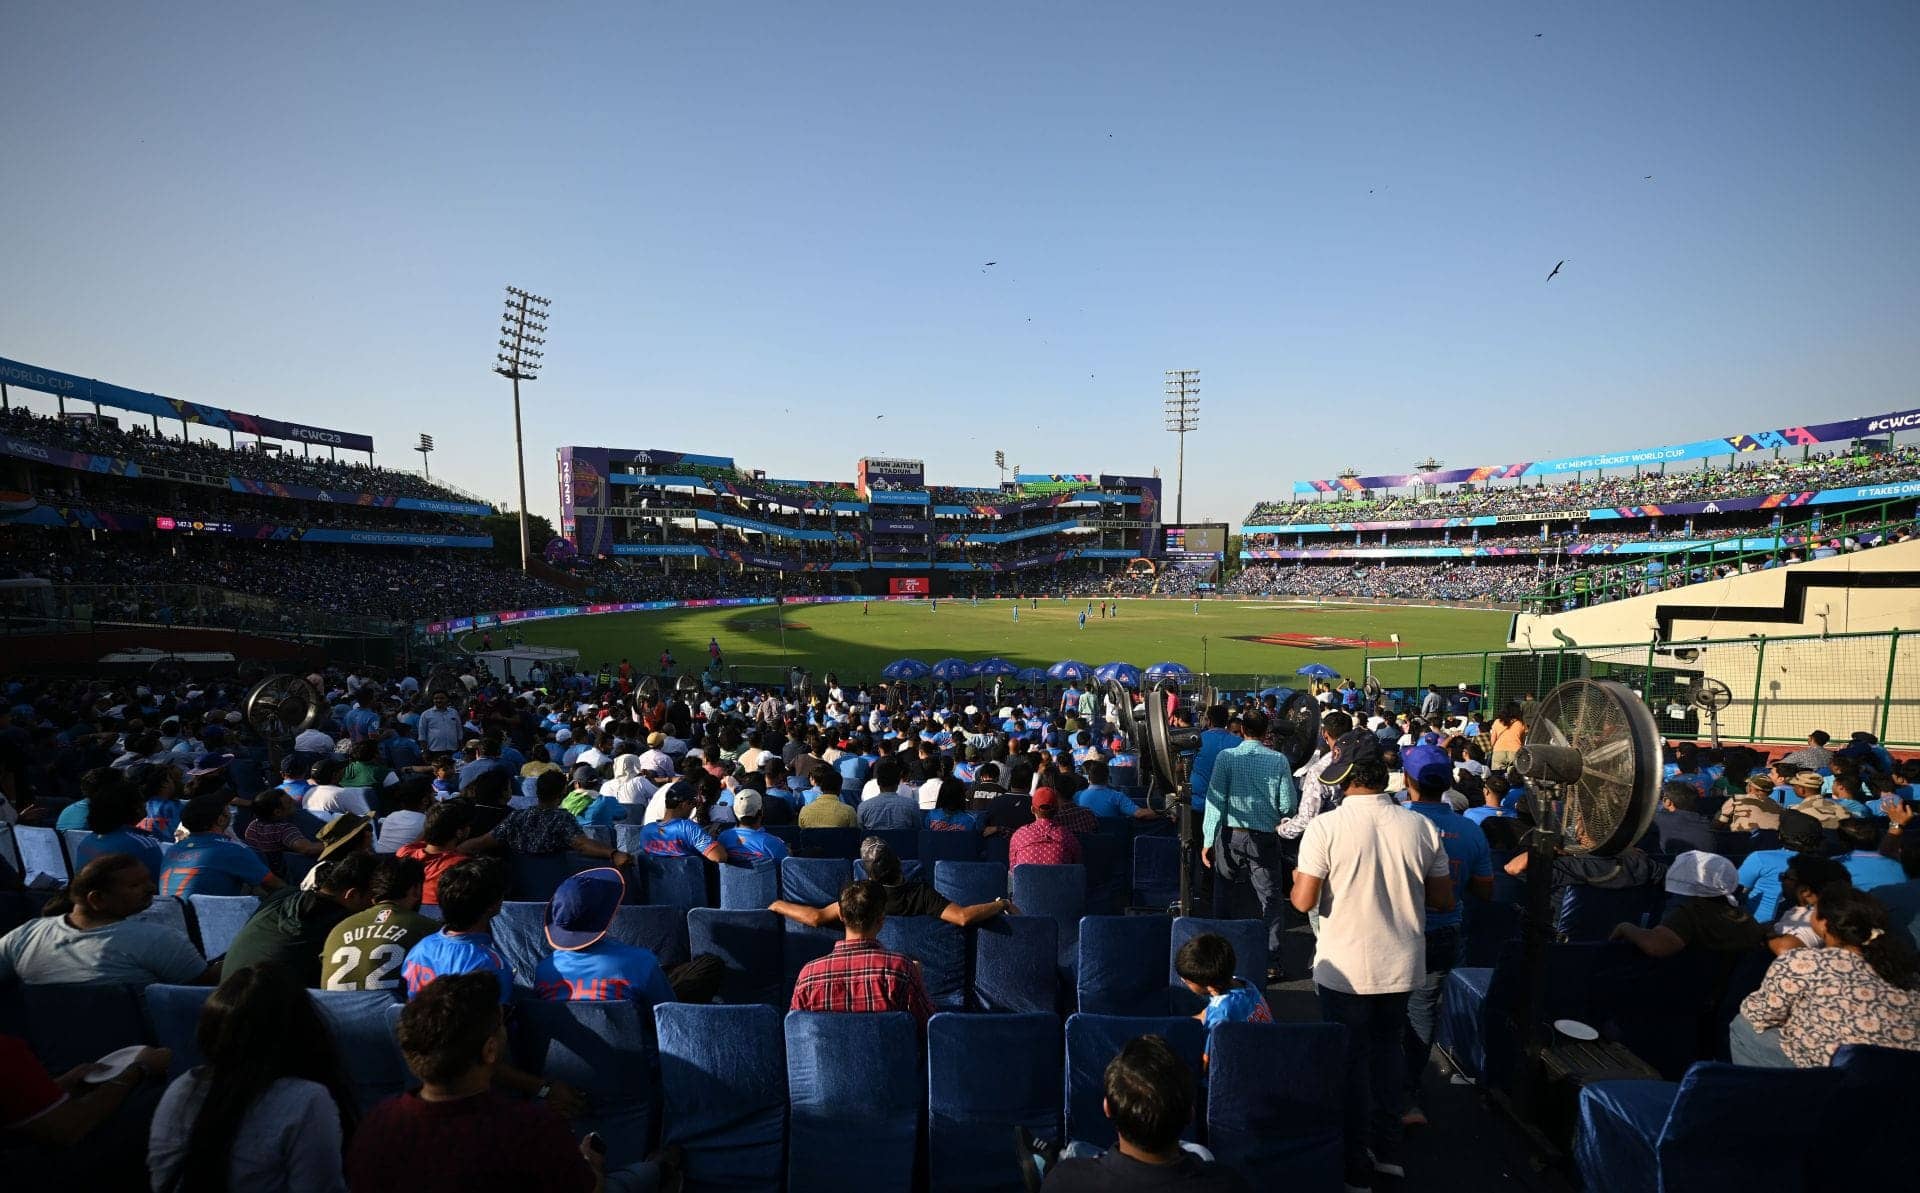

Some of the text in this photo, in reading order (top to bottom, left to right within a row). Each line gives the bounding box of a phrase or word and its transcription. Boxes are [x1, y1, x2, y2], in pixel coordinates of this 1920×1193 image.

[0, 366, 74, 390] WORLD CUP
[292, 428, 341, 443] #CWC23
[1595, 456, 1630, 466] CRICKET
[1631, 452, 1664, 461] WORLD
[1665, 449, 1685, 458] CUP
[1869, 486, 1900, 496] TAKES
[625, 508, 667, 516] GAMBHIR
[670, 509, 697, 517] STAND
[160, 867, 200, 896] 17
[343, 924, 408, 944] BUTLER
[327, 943, 406, 992] 22
